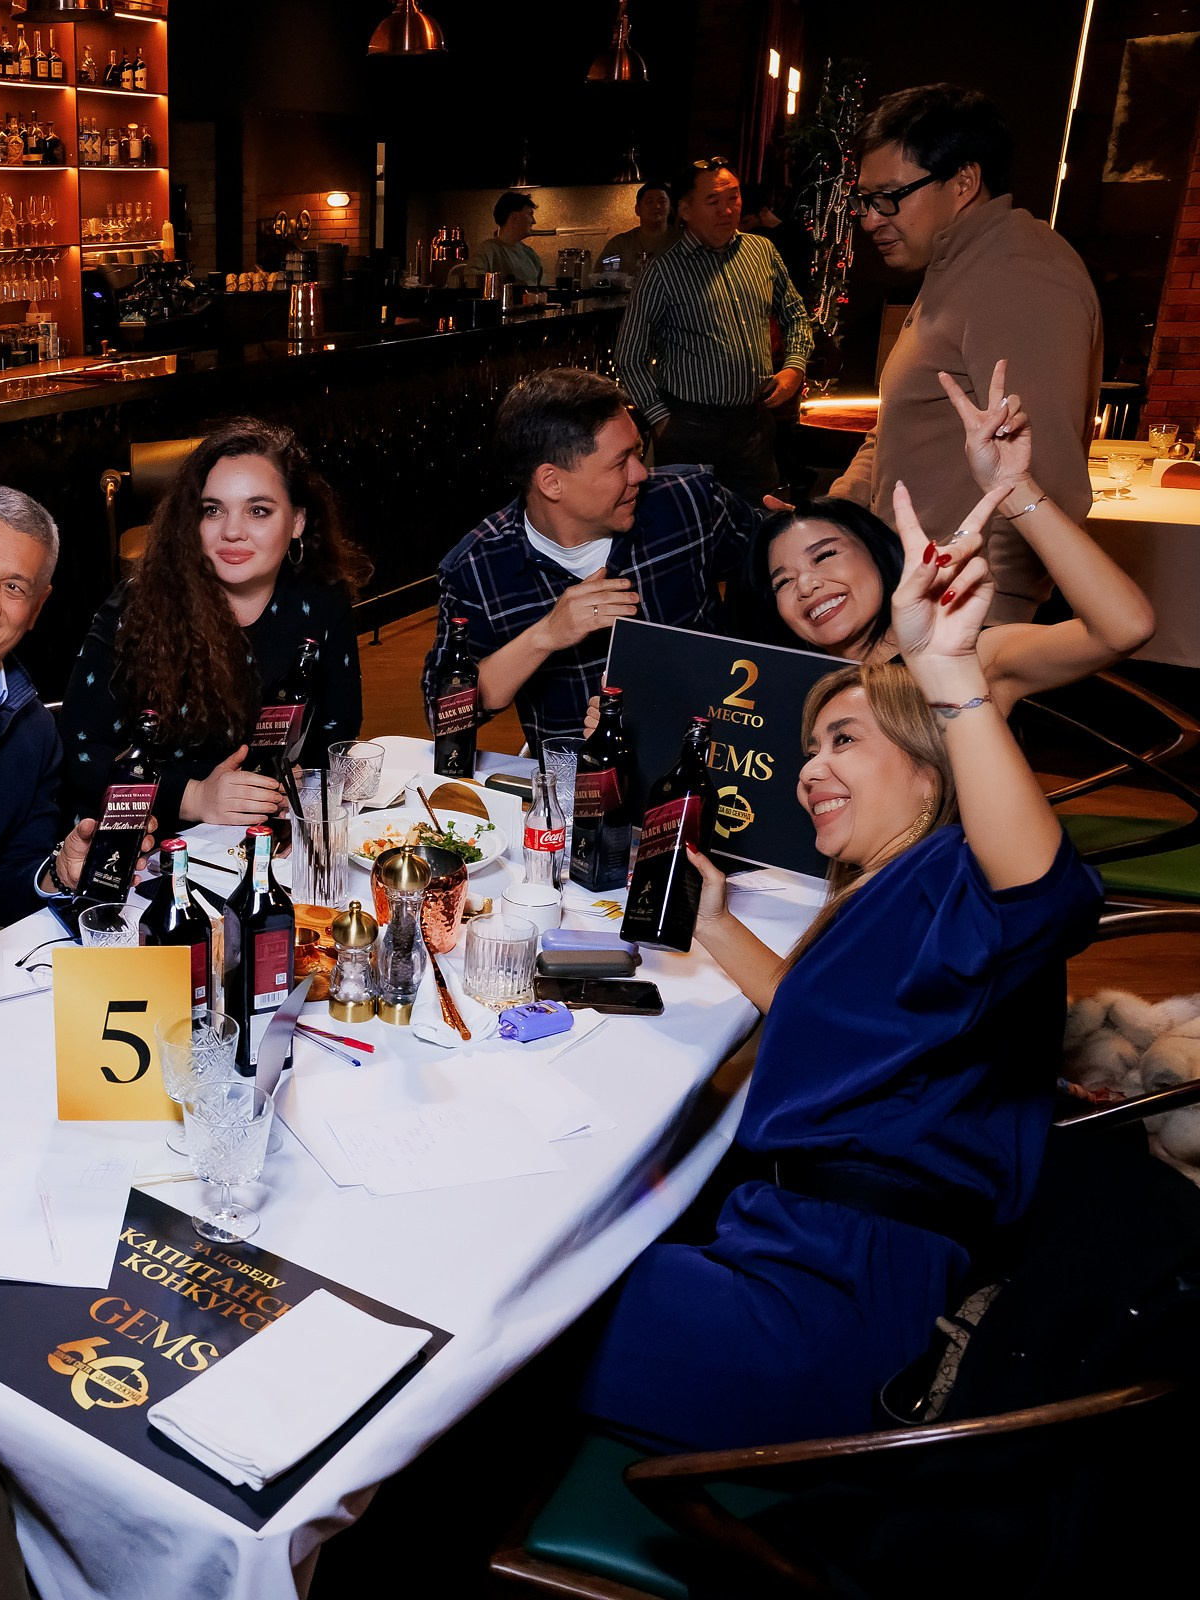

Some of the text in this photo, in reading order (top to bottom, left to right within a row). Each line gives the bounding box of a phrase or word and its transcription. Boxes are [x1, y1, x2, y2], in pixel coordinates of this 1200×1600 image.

[722, 659, 759, 710] 2
[438, 703, 474, 720] BLACK RUBY
[707, 705, 764, 728] МЕСТО
[706, 739, 775, 781] EMS
[107, 801, 151, 811] BLACK RUBY
[641, 825, 662, 840] BLACK
[662, 818, 681, 832] RUBY
[100, 1000, 151, 1083] 5
[189, 1241, 287, 1289] ЗА ПОБЕДУ
[119, 1252, 275, 1334] КОНКУРС
[89, 1296, 220, 1372] GEMS
[95, 1373, 106, 1382] ЗА
[105, 1377, 116, 1387] 60
[114, 1381, 142, 1402] СЕКУНД
